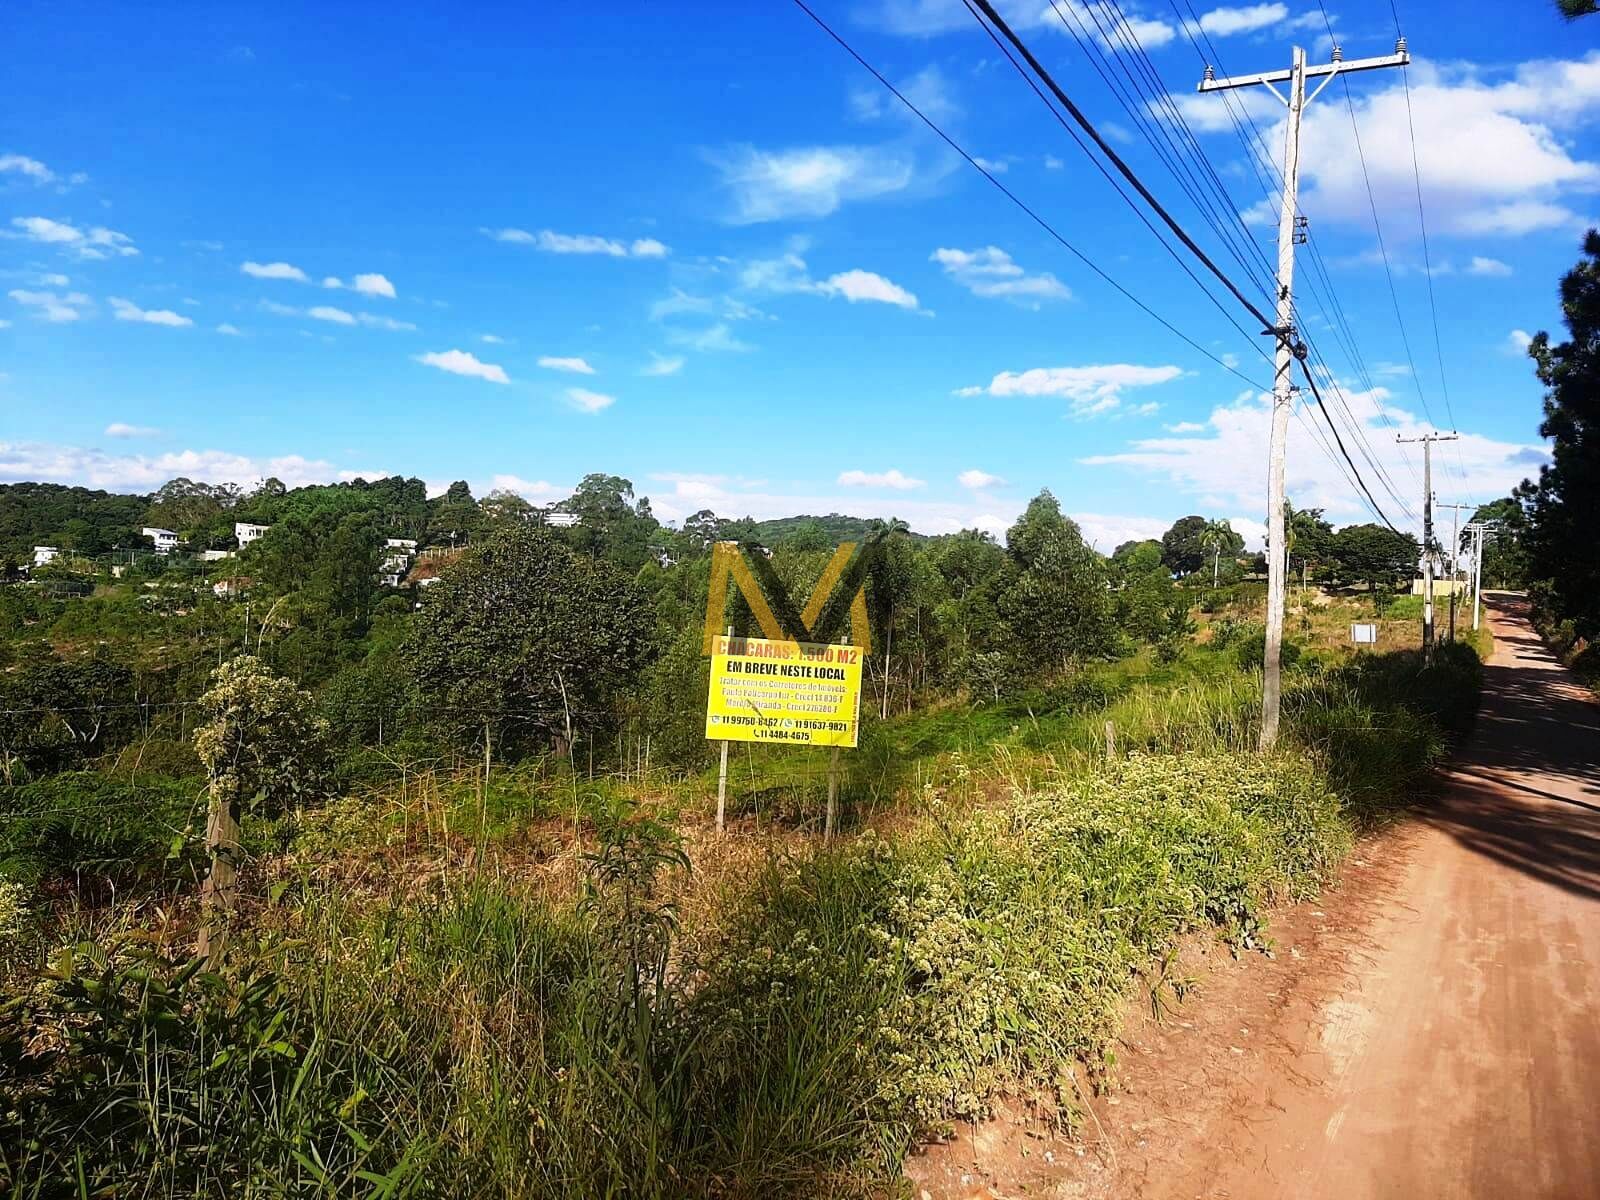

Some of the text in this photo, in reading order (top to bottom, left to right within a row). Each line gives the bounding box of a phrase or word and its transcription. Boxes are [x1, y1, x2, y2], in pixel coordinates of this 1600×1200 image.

[837, 648, 858, 665] M2
[727, 660, 846, 680] EM BREVE NESTE LOCAL
[722, 715, 730, 724] 11
[795, 720, 803, 728] 11
[760, 729, 768, 738] 11
